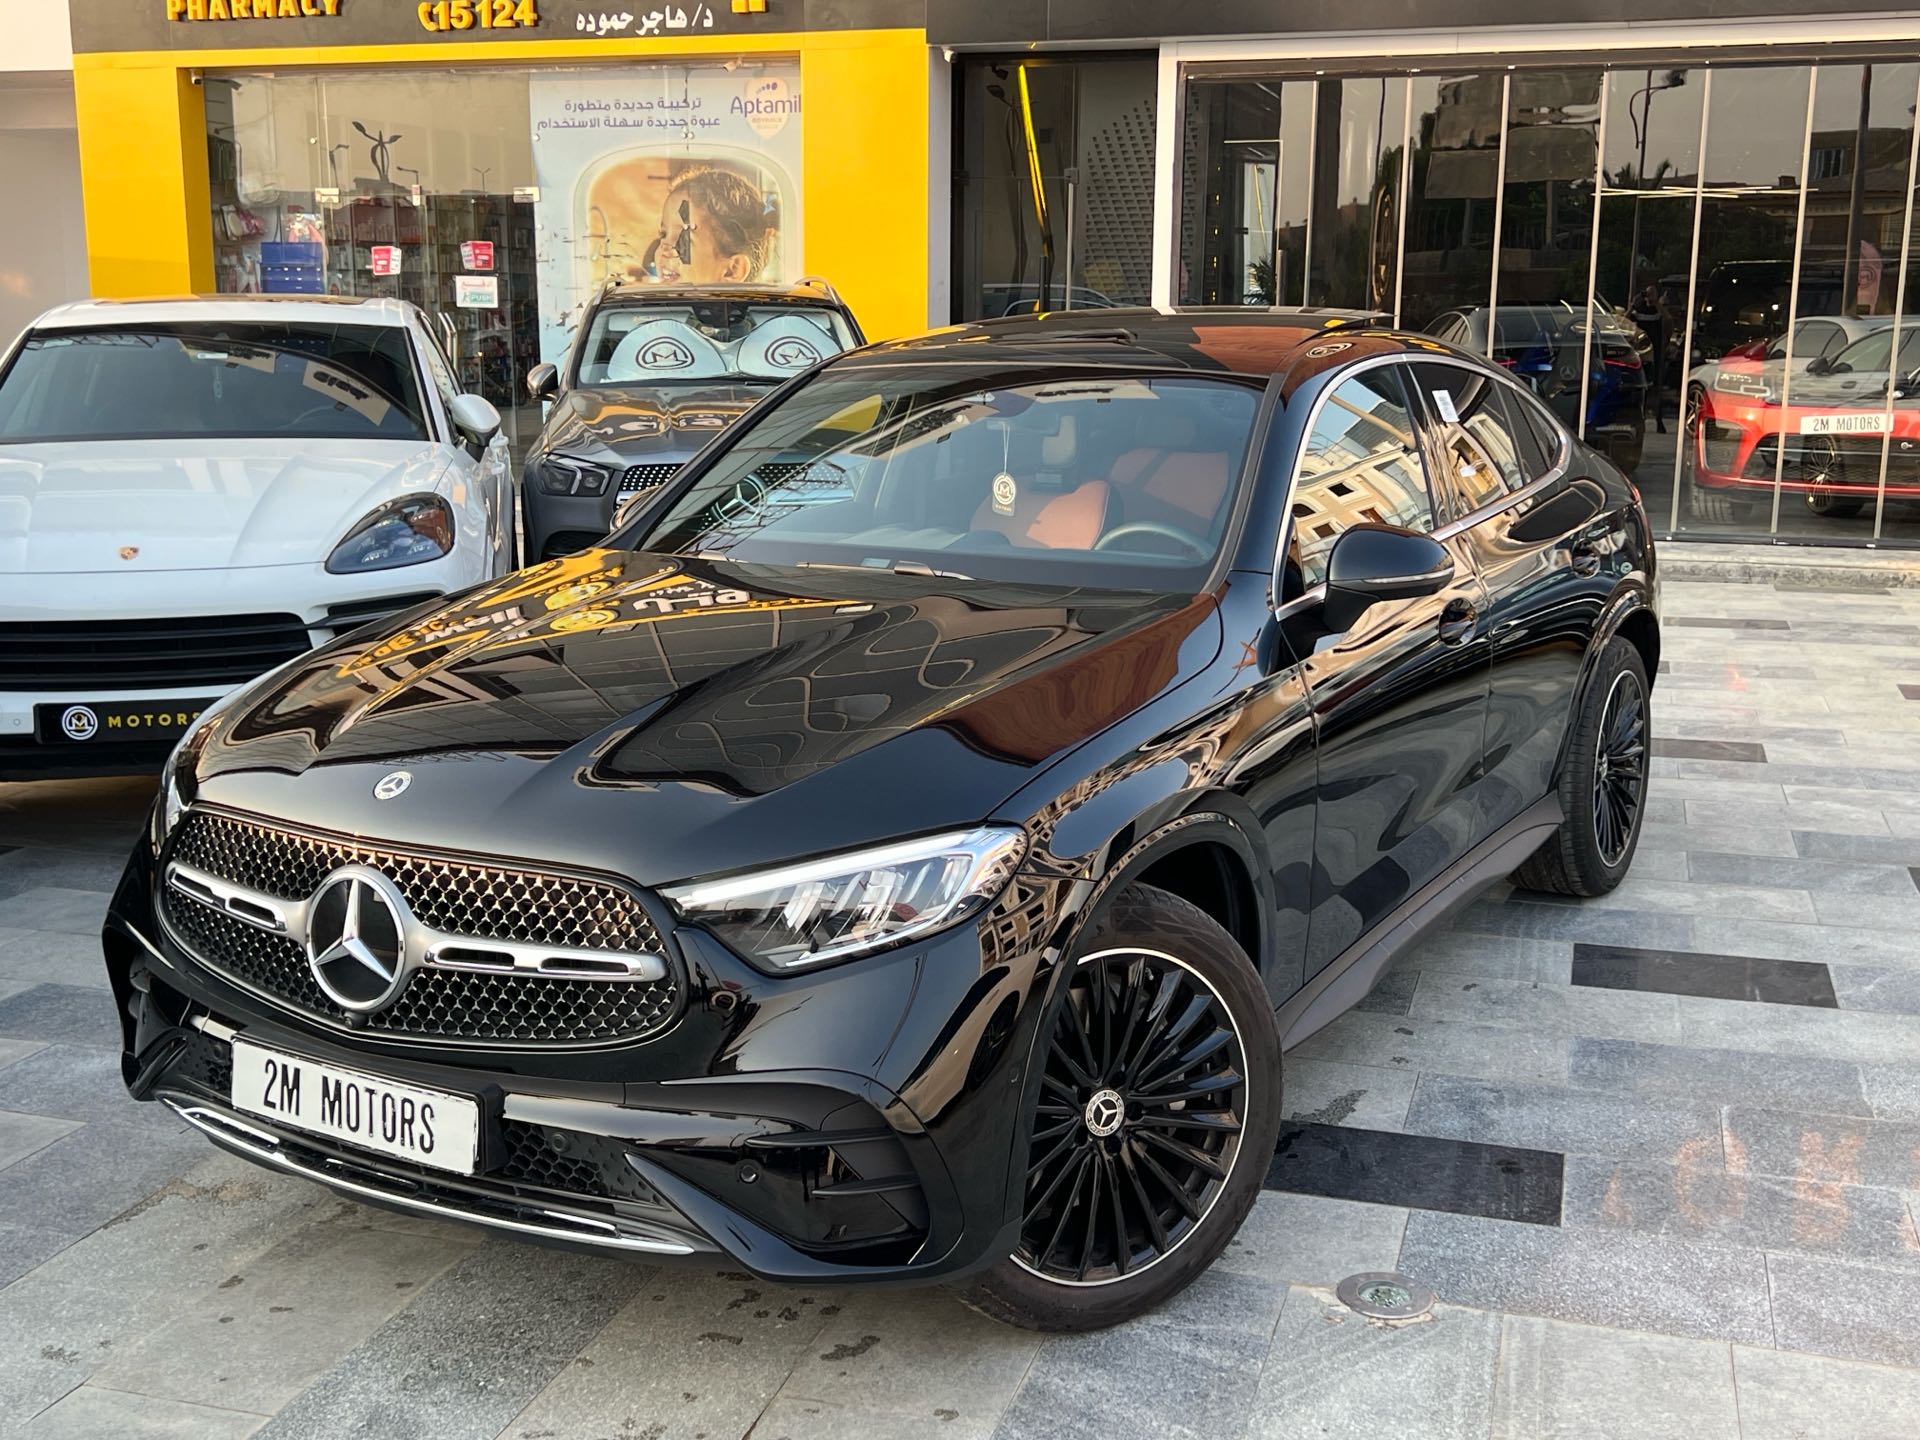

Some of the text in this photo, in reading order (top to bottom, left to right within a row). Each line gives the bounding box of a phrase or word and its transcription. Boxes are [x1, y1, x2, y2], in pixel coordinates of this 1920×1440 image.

[166, 0, 340, 21] PHARMACY
[635, 5, 688, 36] هاجر
[564, 95, 702, 113] تركيبة جديدة متطورة
[730, 93, 803, 118] Aptamil
[536, 115, 721, 131] عبوة جديدة سهلة الاستخدام
[1813, 416, 1880, 432] 2M MOTORS
[263, 1058, 435, 1154] 2M MOTORS
